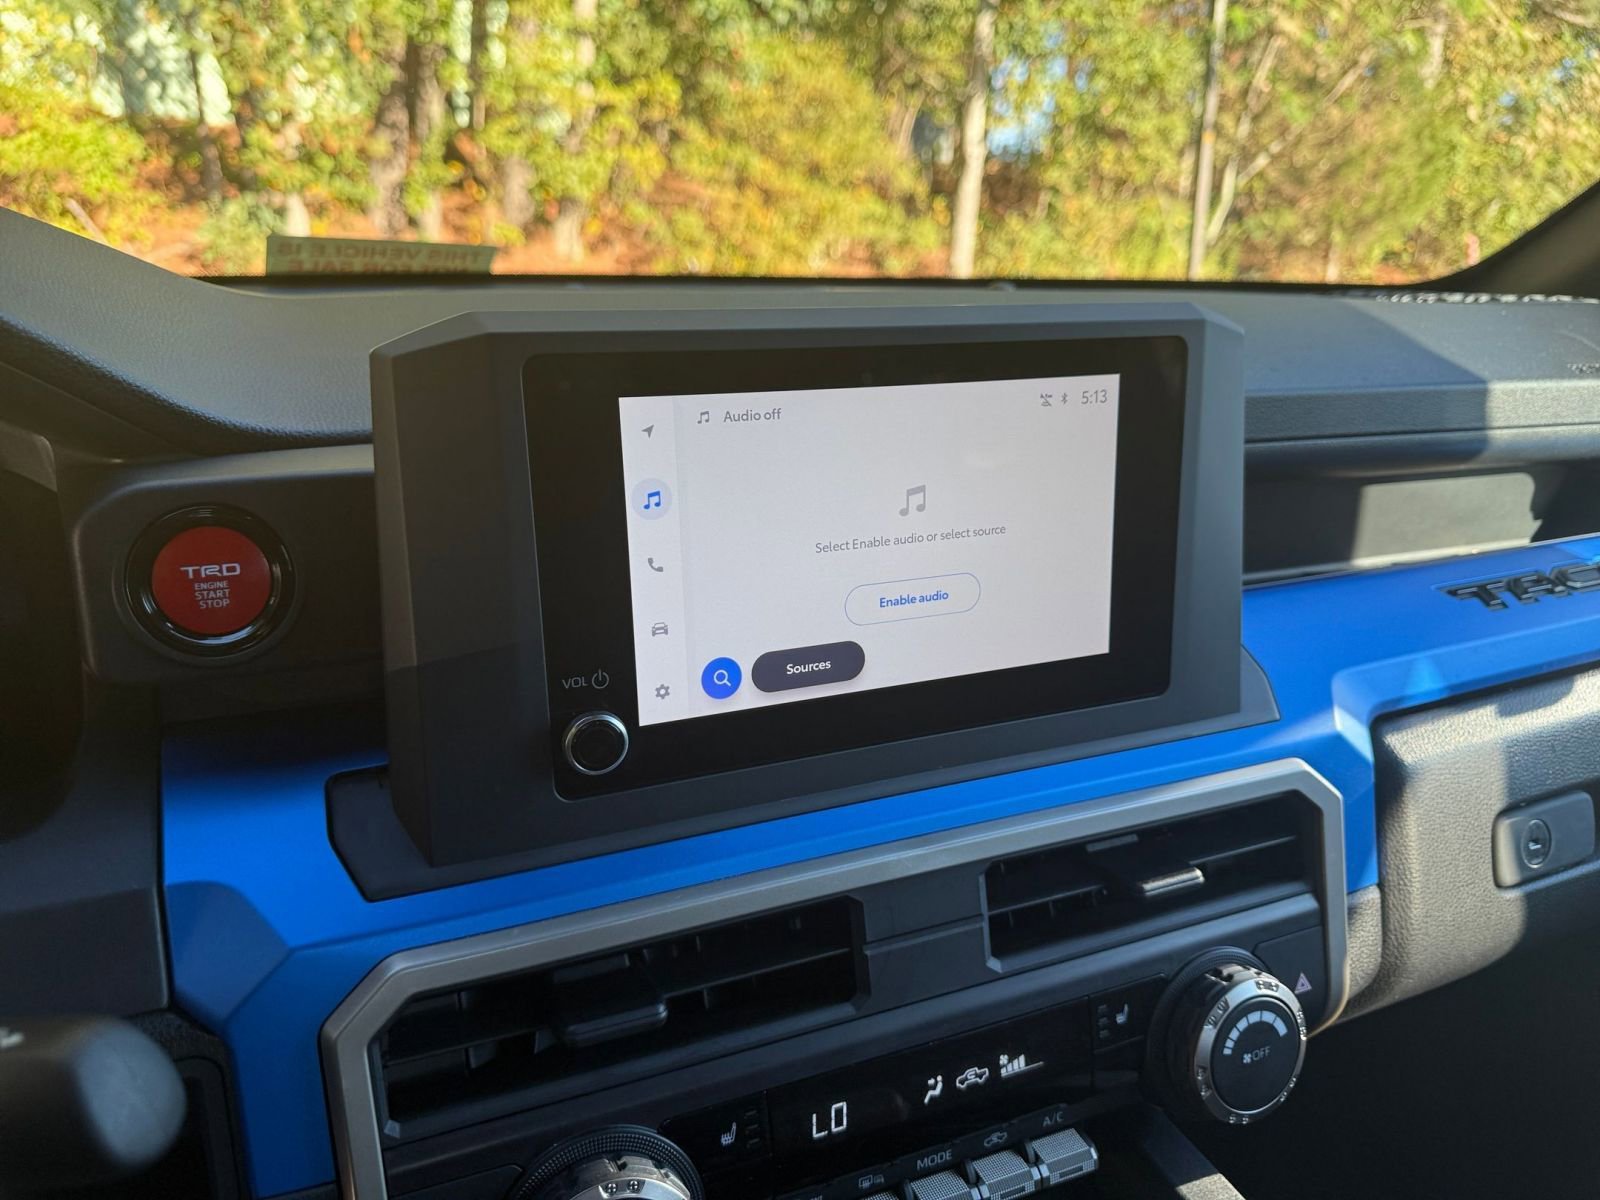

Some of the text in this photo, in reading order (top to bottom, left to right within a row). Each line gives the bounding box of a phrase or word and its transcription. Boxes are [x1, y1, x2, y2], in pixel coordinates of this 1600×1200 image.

[1081, 389, 1108, 405] 5:13
[723, 407, 782, 422] Audio off
[815, 525, 1007, 554] Select Enable audio or select source
[180, 563, 241, 579] TRD
[194, 580, 229, 590] ENGINE
[195, 589, 230, 600] START
[879, 590, 949, 608] Enable audio
[199, 599, 230, 609] STOP
[786, 660, 832, 675] Sources
[562, 676, 589, 689] VOL
[1252, 1046, 1271, 1061] OFF
[1042, 1111, 1064, 1127] A/C
[916, 1149, 953, 1171] MODE
